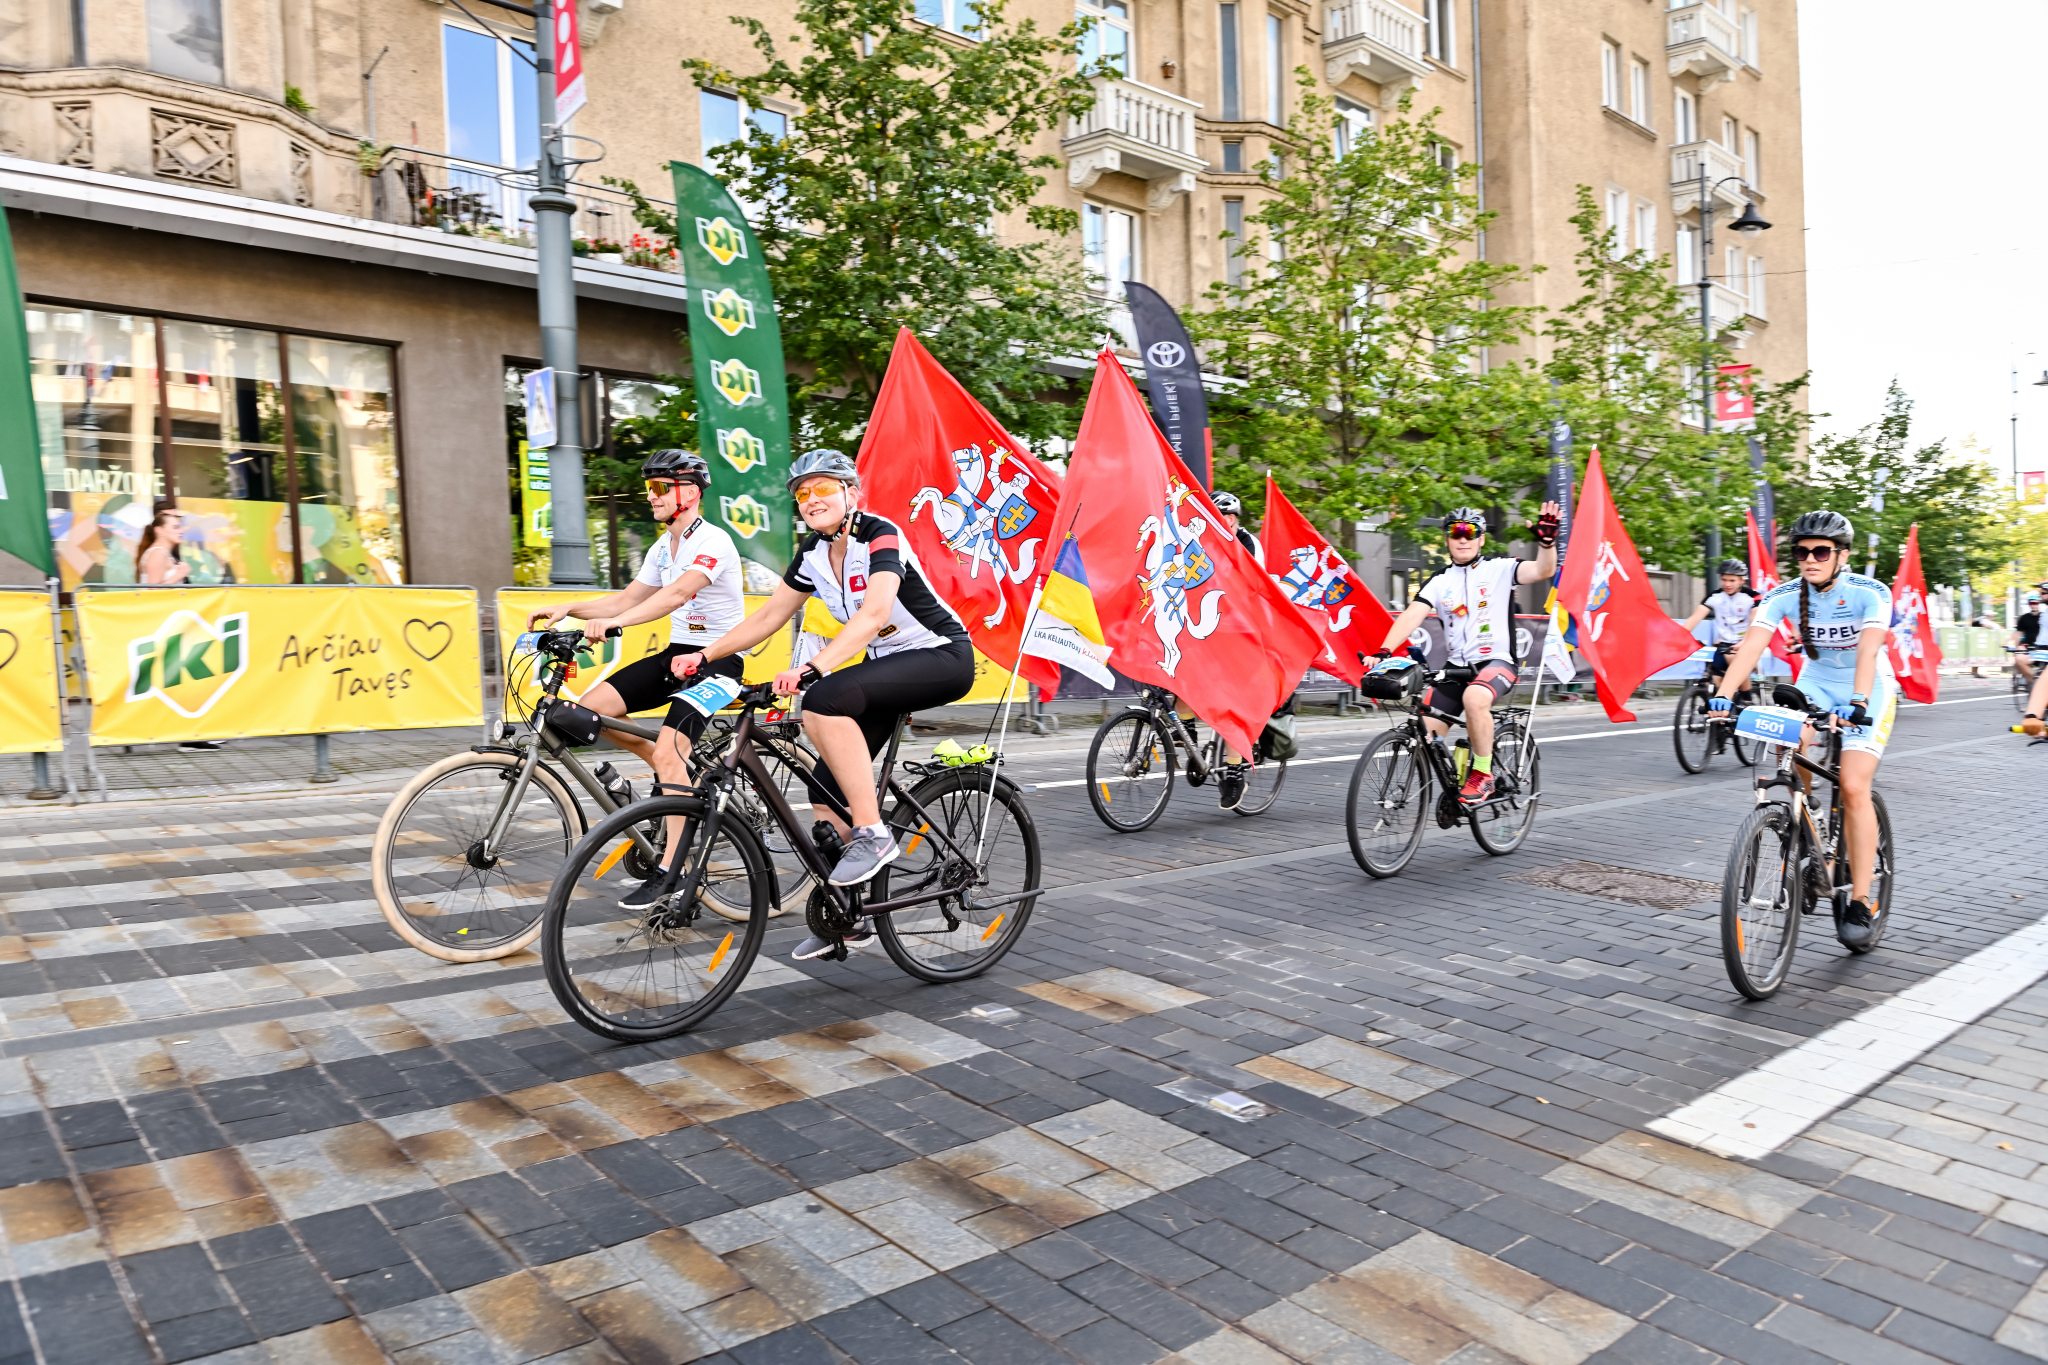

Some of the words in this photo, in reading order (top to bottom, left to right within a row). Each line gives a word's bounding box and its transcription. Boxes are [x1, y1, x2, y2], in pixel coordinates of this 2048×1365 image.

[63, 465, 181, 496] DARŽOVĖ
[1034, 630, 1046, 639] LKA
[1799, 624, 1860, 639] EPPEL
[133, 617, 242, 696] iki
[278, 633, 382, 672] Arčiau
[332, 667, 413, 702] Tavęs
[1755, 718, 1785, 735] 1501
[768, 739, 801, 767] SCOTT
